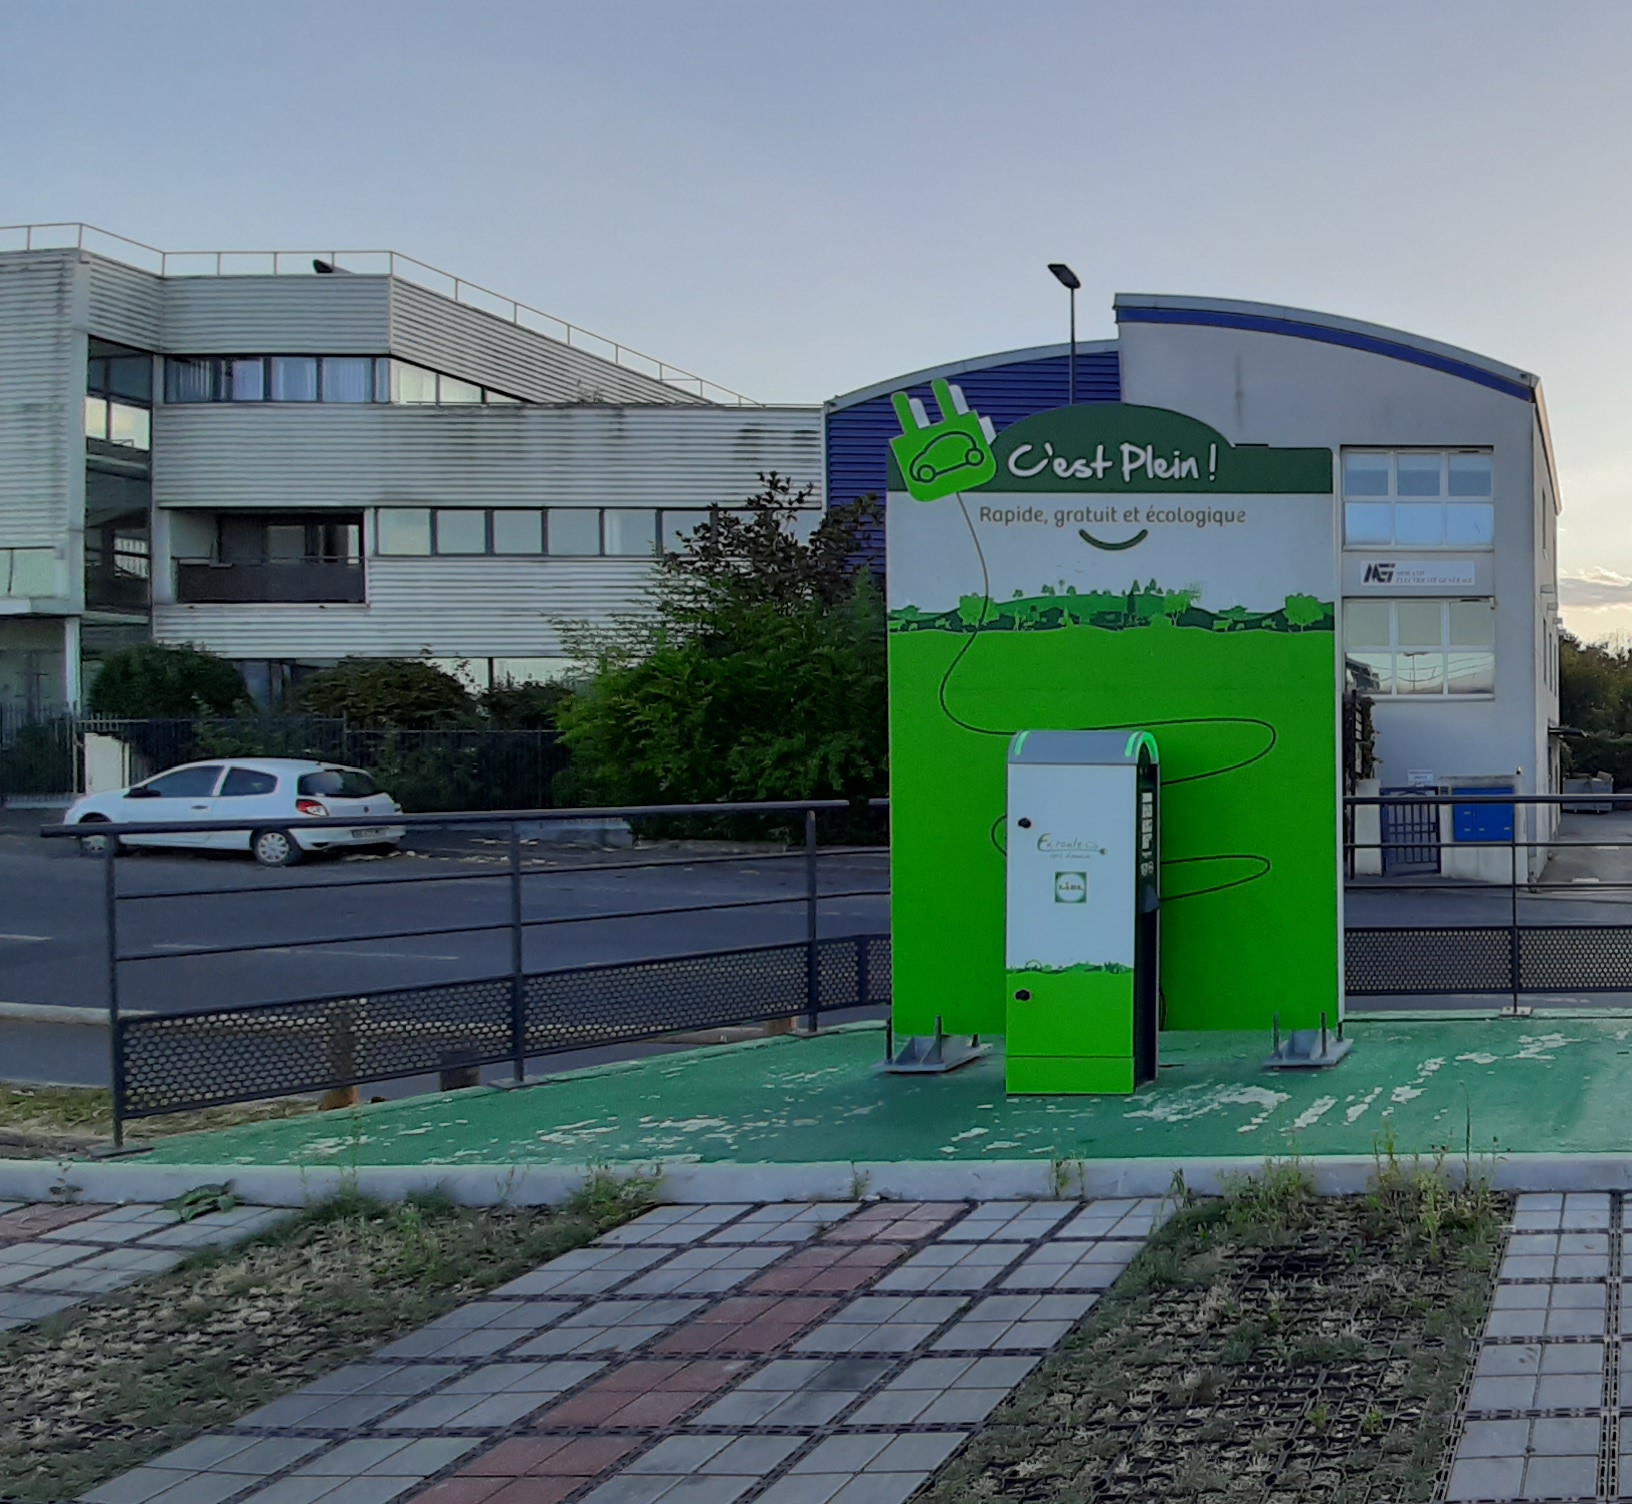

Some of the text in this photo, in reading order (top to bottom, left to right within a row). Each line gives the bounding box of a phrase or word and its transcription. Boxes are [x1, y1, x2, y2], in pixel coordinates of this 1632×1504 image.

[1009, 443, 1217, 482] C'est Plein !
[979, 504, 1247, 528] Rapide, gratuit et écologique
